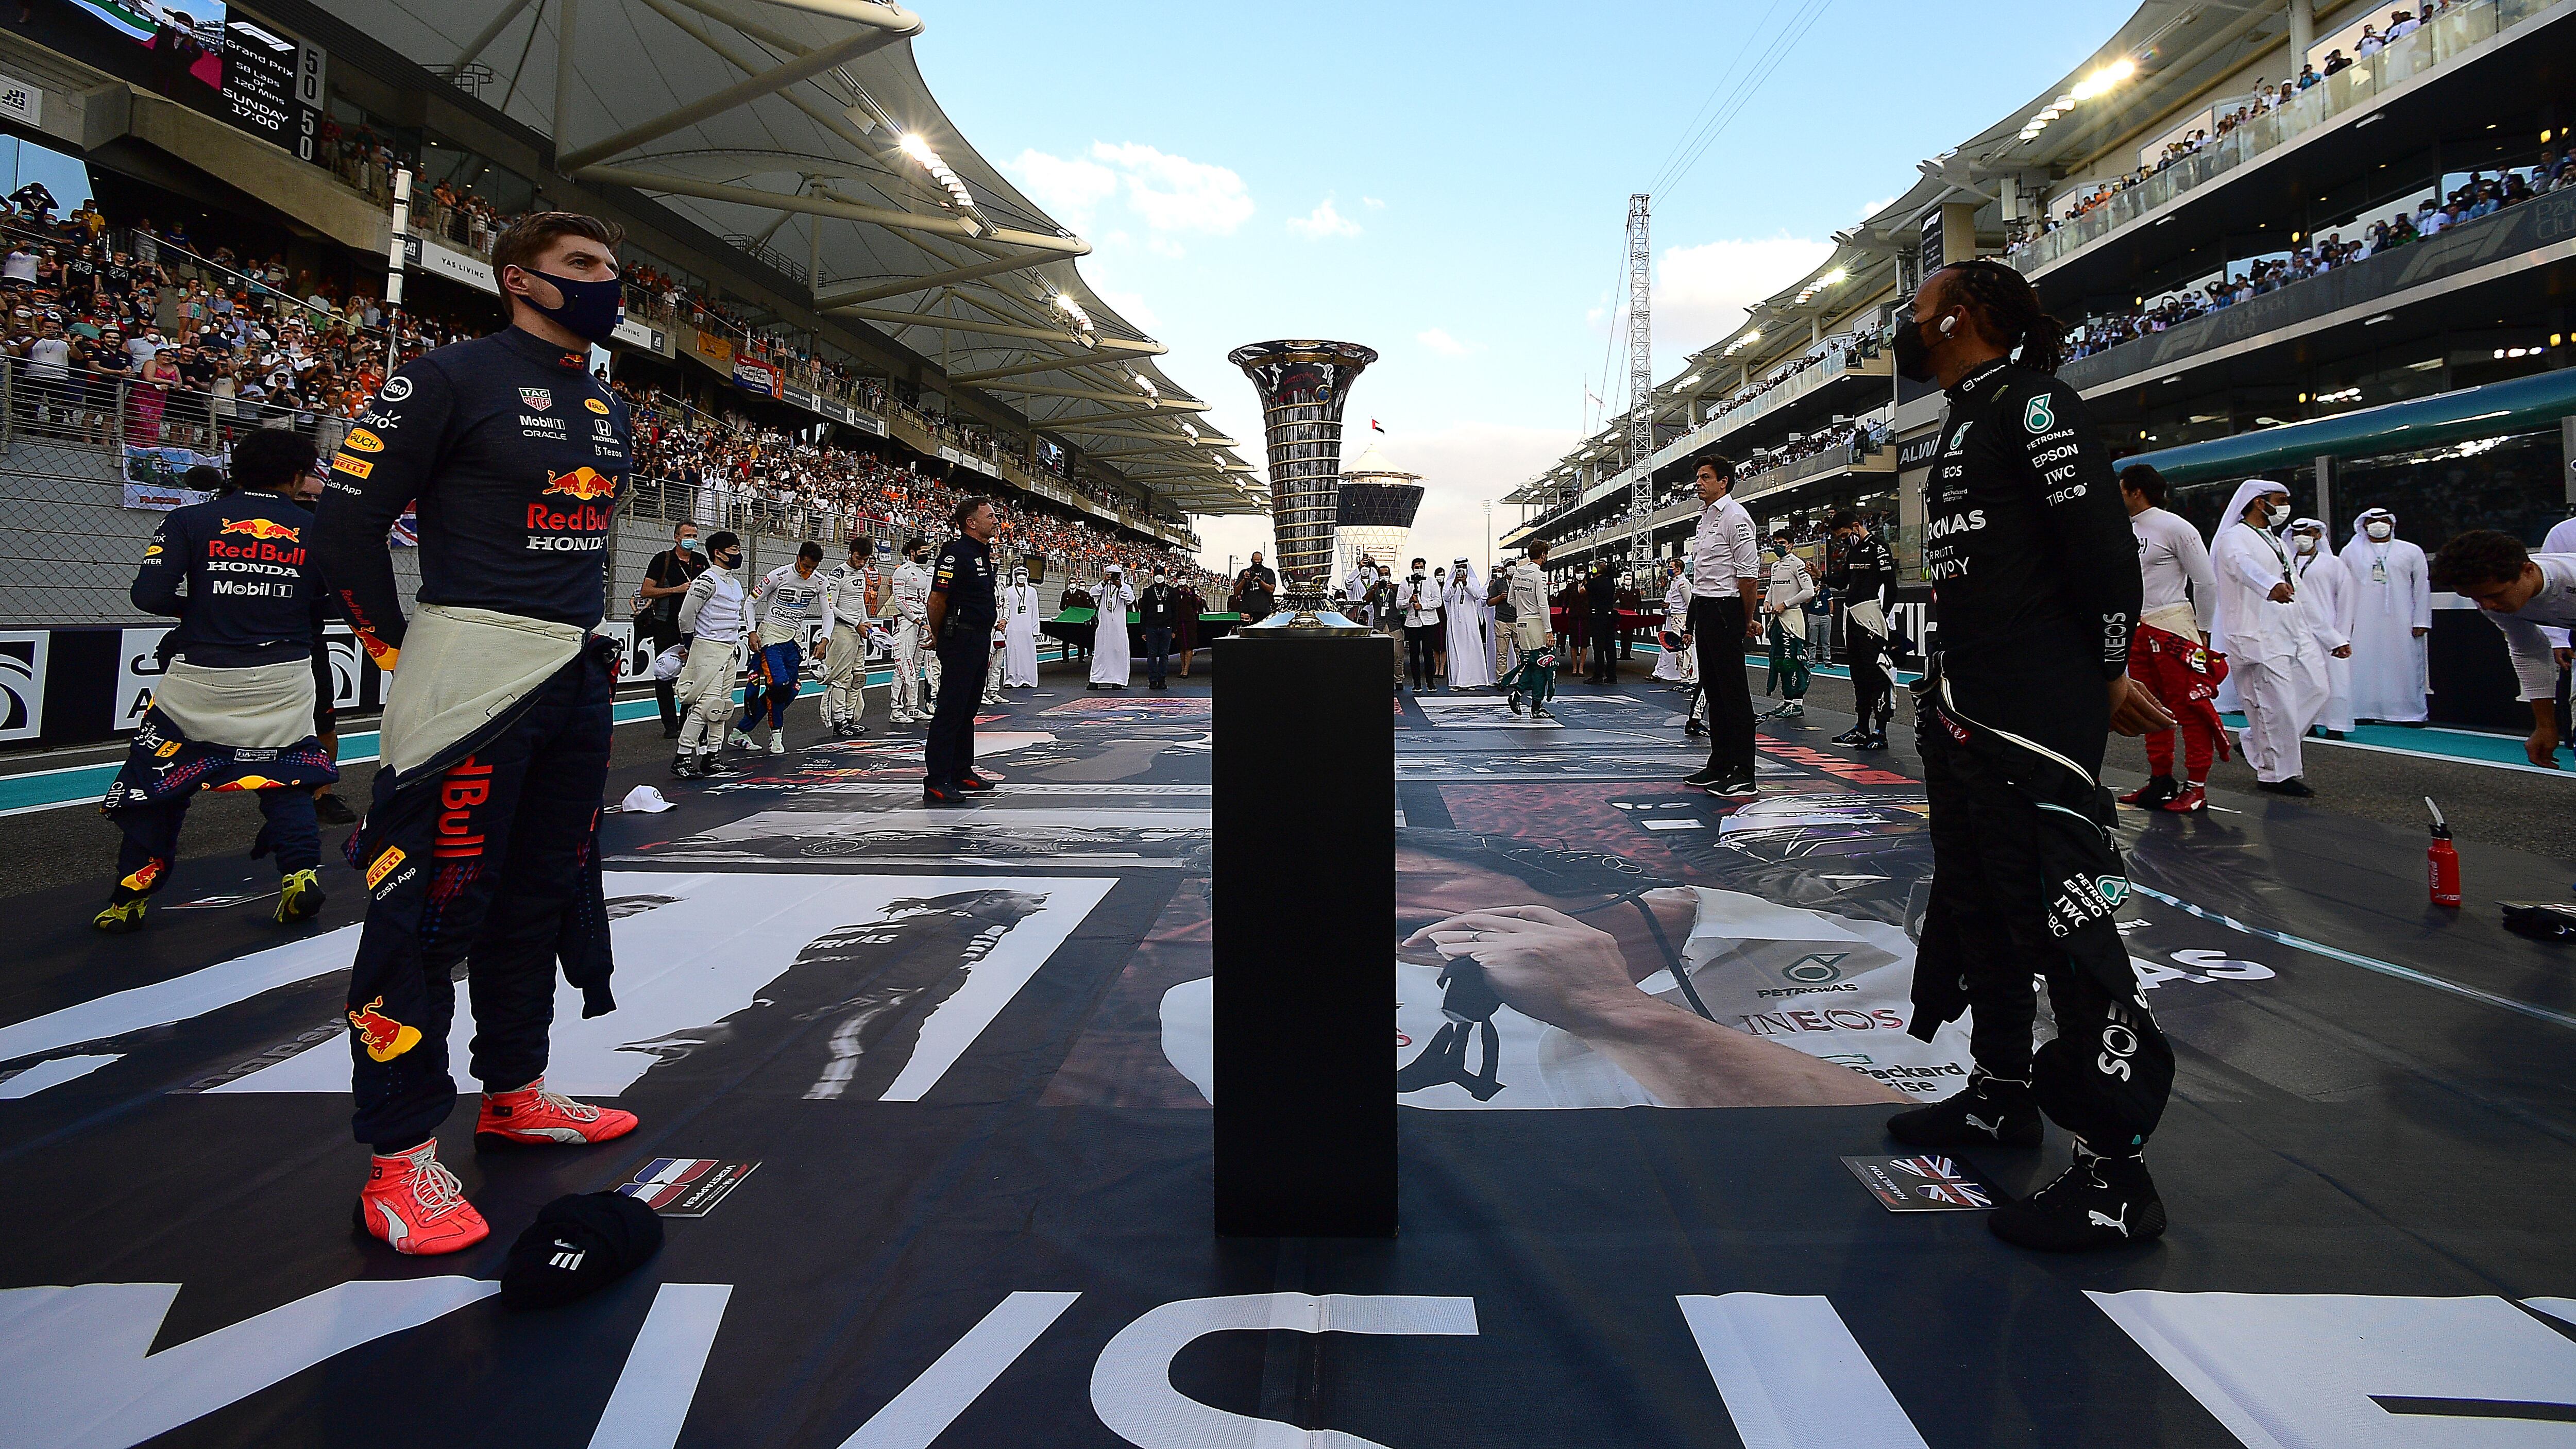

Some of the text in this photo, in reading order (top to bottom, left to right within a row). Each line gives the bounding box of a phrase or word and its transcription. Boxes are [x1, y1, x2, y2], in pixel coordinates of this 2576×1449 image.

[226, 39, 293, 77] Grand Prix
[236, 61, 280, 87] 58 Laps
[234, 77, 284, 105] 120 Mins
[223, 88, 289, 122] SUNDAY
[232, 103, 279, 130] 17:00
[442, 258, 484, 279] YAS LIVING
[622, 327, 640, 338] LIVING
[741, 366, 768, 384] 33
[522, 390, 548, 398] TAG
[524, 397, 551, 409] HEUER
[519, 415, 554, 428] Mobil
[522, 430, 567, 440] ORACLE
[591, 435, 619, 444] HONDA
[2026, 429, 2075, 451] PETRONAS
[603, 447, 622, 458] Tezos
[2032, 444, 2078, 468] EPSON
[335, 460, 364, 474] RELLI
[1942, 465, 1962, 479] EOS
[2044, 464, 2076, 485] IWC
[327, 479, 362, 496] Cash App
[527, 502, 585, 531] Red
[209, 540, 306, 565] Red Bull
[207, 562, 300, 578] HONDA
[1930, 557, 1970, 580] NVOY
[213, 580, 270, 596] Mobil
[2103, 612, 2126, 663] INEOS
[433, 779, 489, 857] Bull
[368, 854, 401, 887] RELLI
[376, 867, 416, 901] Cash App
[2063, 879, 2103, 918] EPSO
[2048, 908, 2070, 938] IBC
[1757, 984, 1859, 999] PETRONAS
[1739, 1009, 1904, 1036] INEOS
[2097, 999, 2138, 1082] EOS
[682, 1165, 737, 1207] VERSTAPPEN
[1868, 1165, 1909, 1201] HAMILTON
